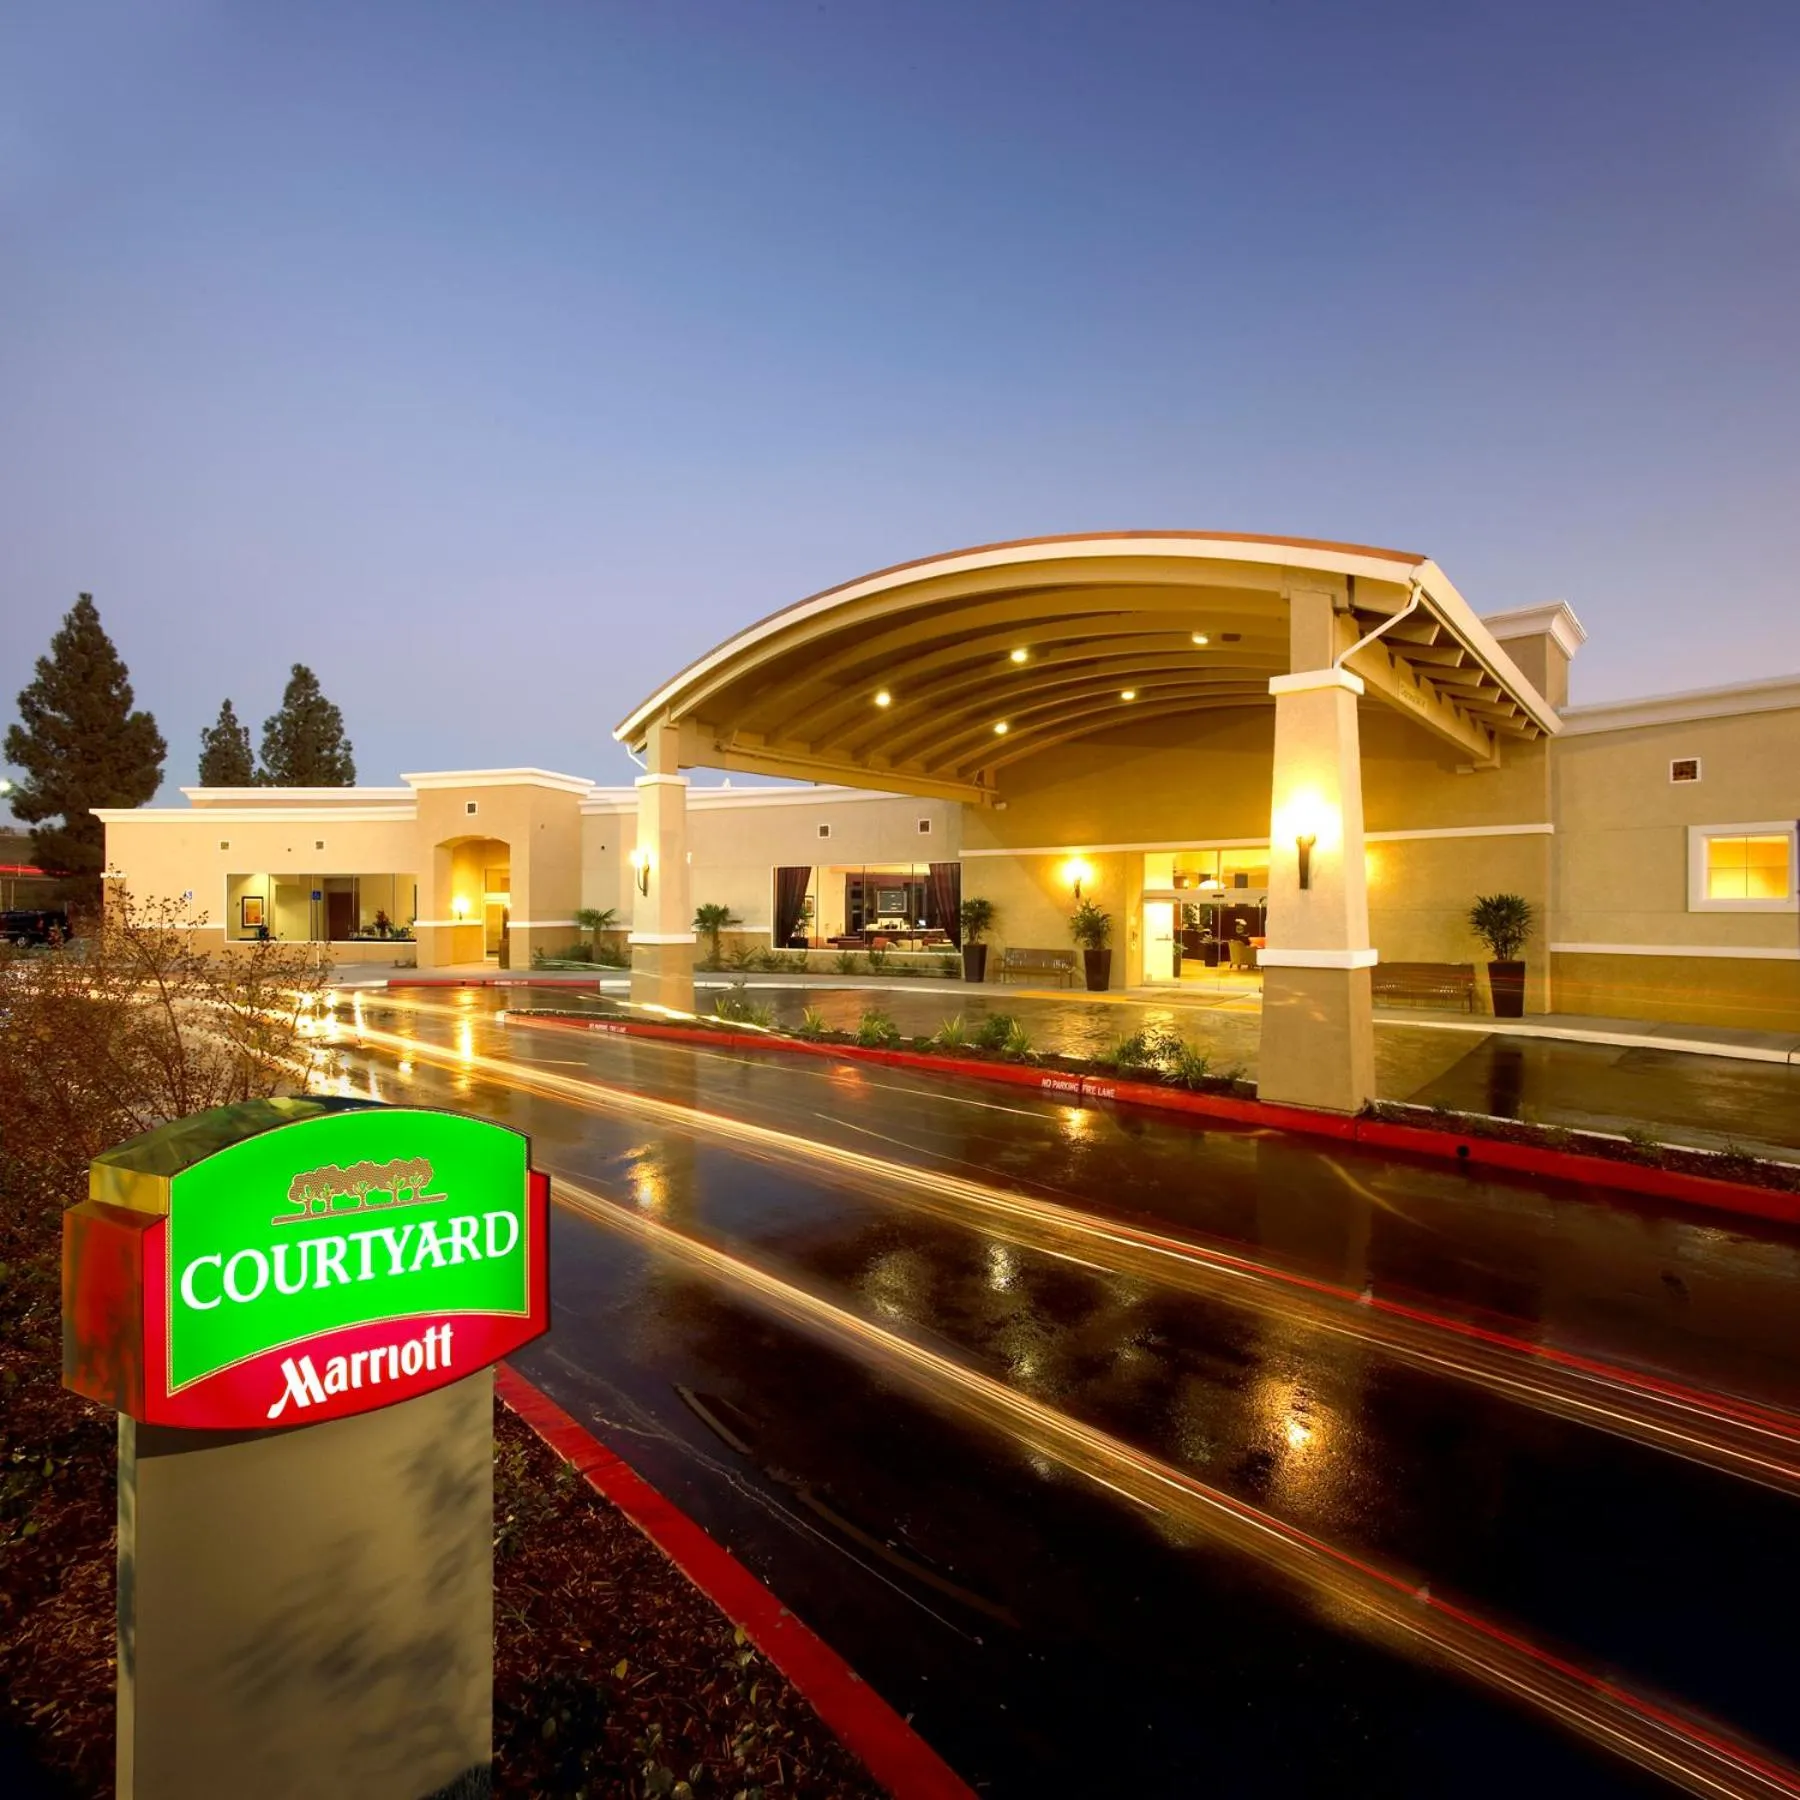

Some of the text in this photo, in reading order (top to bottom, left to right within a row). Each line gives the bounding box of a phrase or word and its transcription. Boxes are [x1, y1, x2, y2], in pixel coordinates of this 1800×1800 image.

[1041, 1078, 1115, 1098] NO PARKING FIRE LANE
[180, 1210, 520, 1310] COURTYARD
[266, 1322, 454, 1420] Marriott
